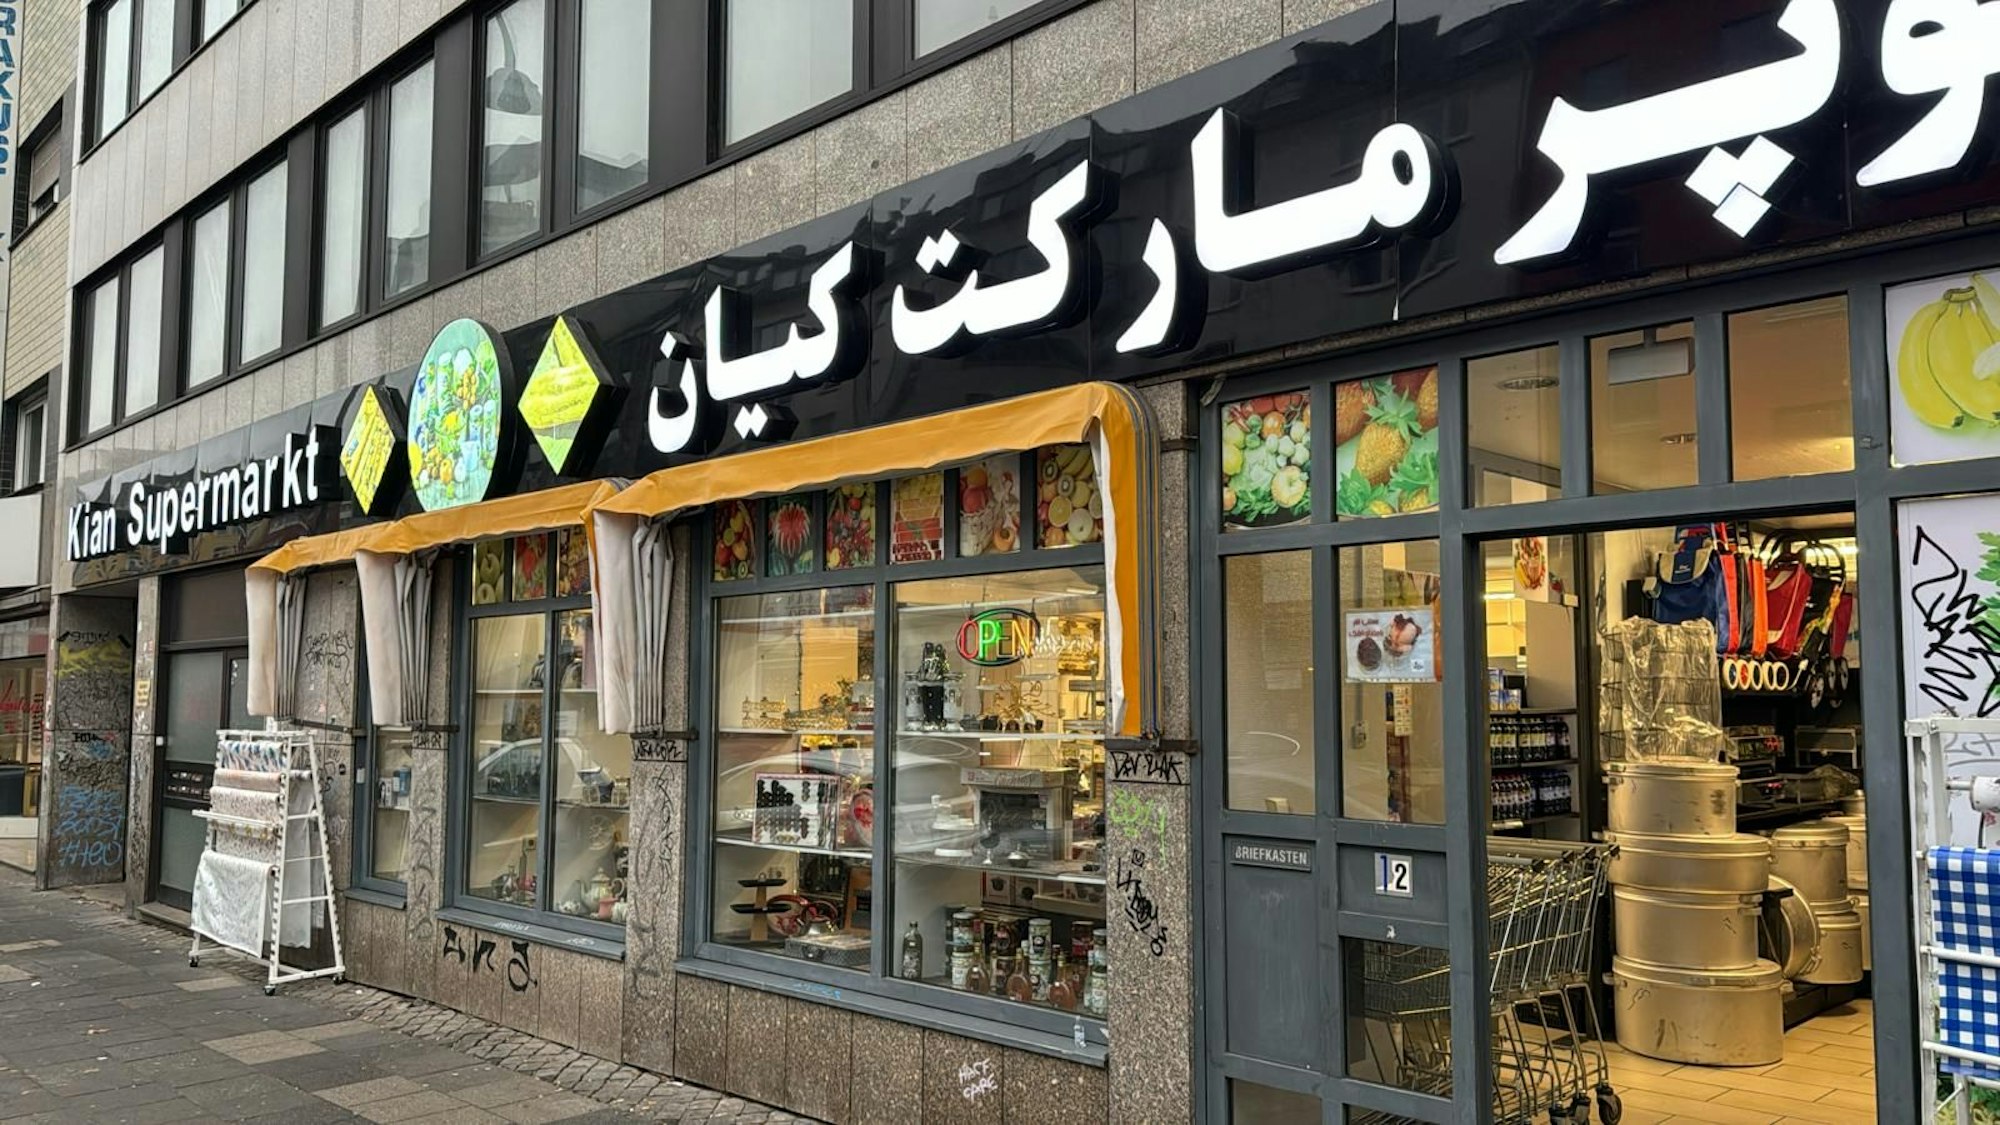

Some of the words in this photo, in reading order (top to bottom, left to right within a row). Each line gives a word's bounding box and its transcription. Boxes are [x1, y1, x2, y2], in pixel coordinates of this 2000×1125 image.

[68, 503, 117, 561] Kian
[127, 425, 319, 554] Supermarkt
[958, 618, 1031, 660] OPEN
[1235, 845, 1308, 866] BRIEFKASTEN
[1380, 854, 1407, 893] 12
